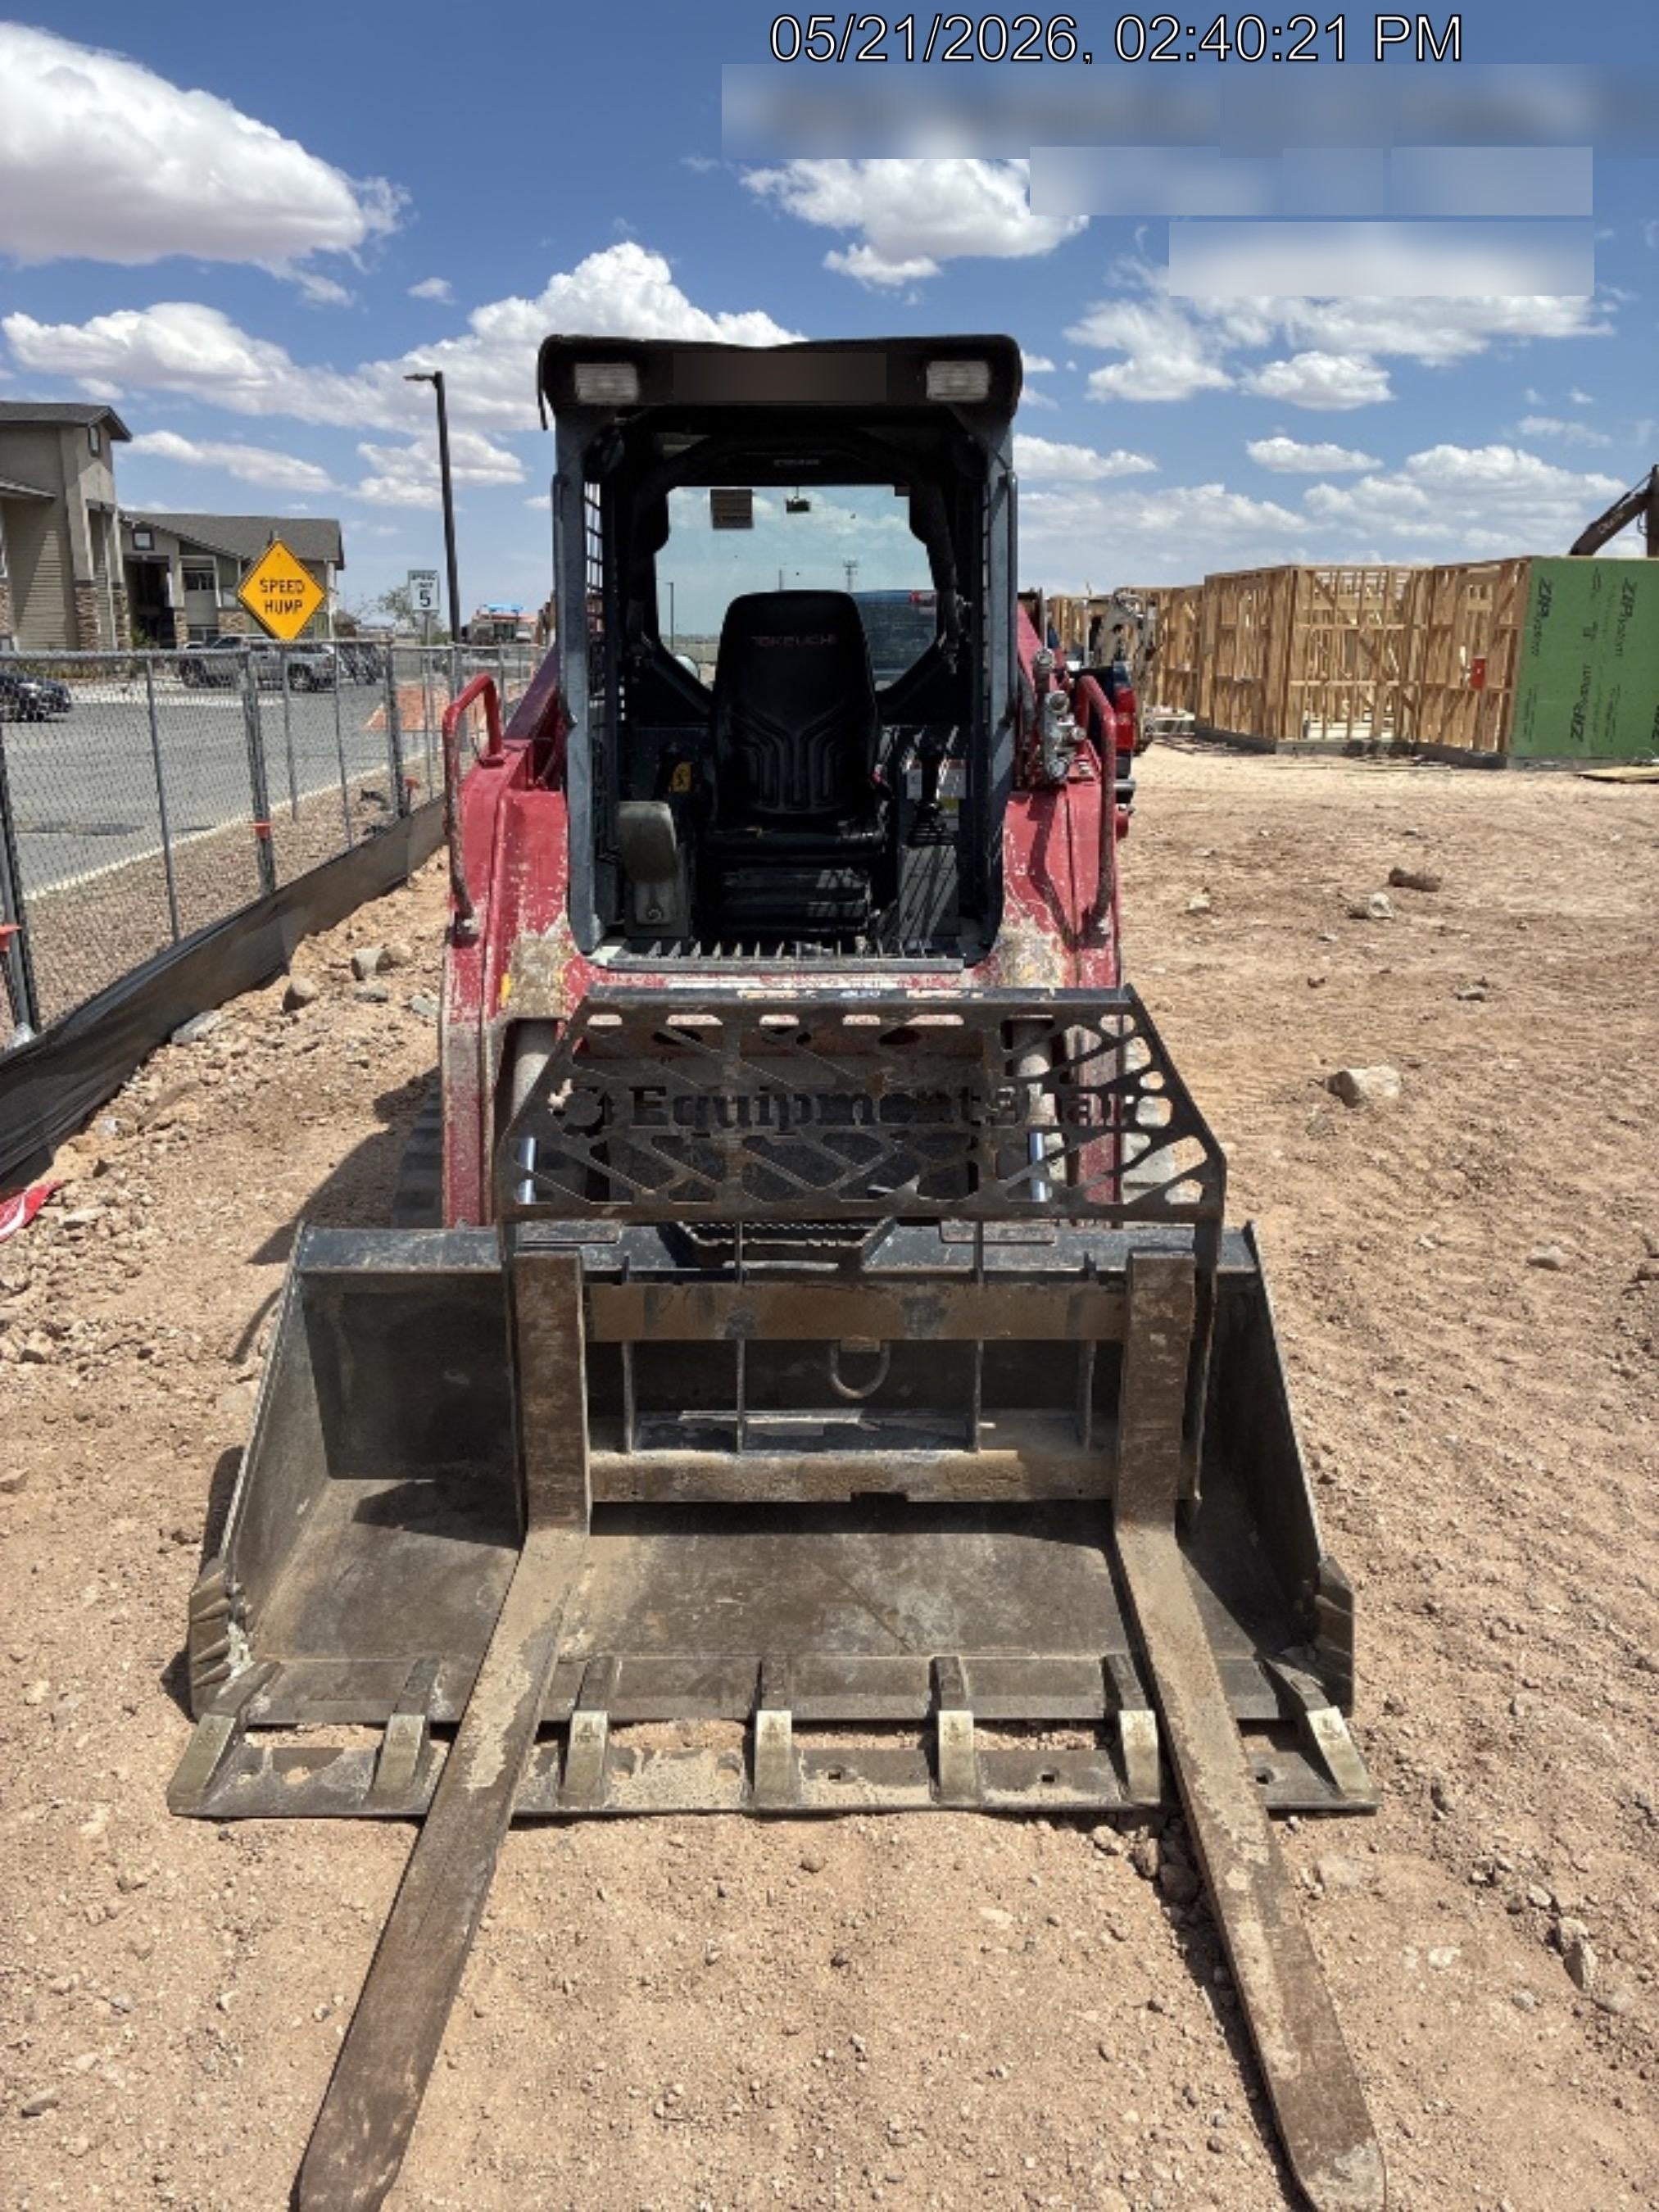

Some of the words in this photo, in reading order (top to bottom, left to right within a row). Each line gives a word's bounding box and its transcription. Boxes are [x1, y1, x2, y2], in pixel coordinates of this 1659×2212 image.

[259, 578, 306, 594] SPEED
[419, 589, 431, 607] 5
[265, 599, 303, 614] HUMP
